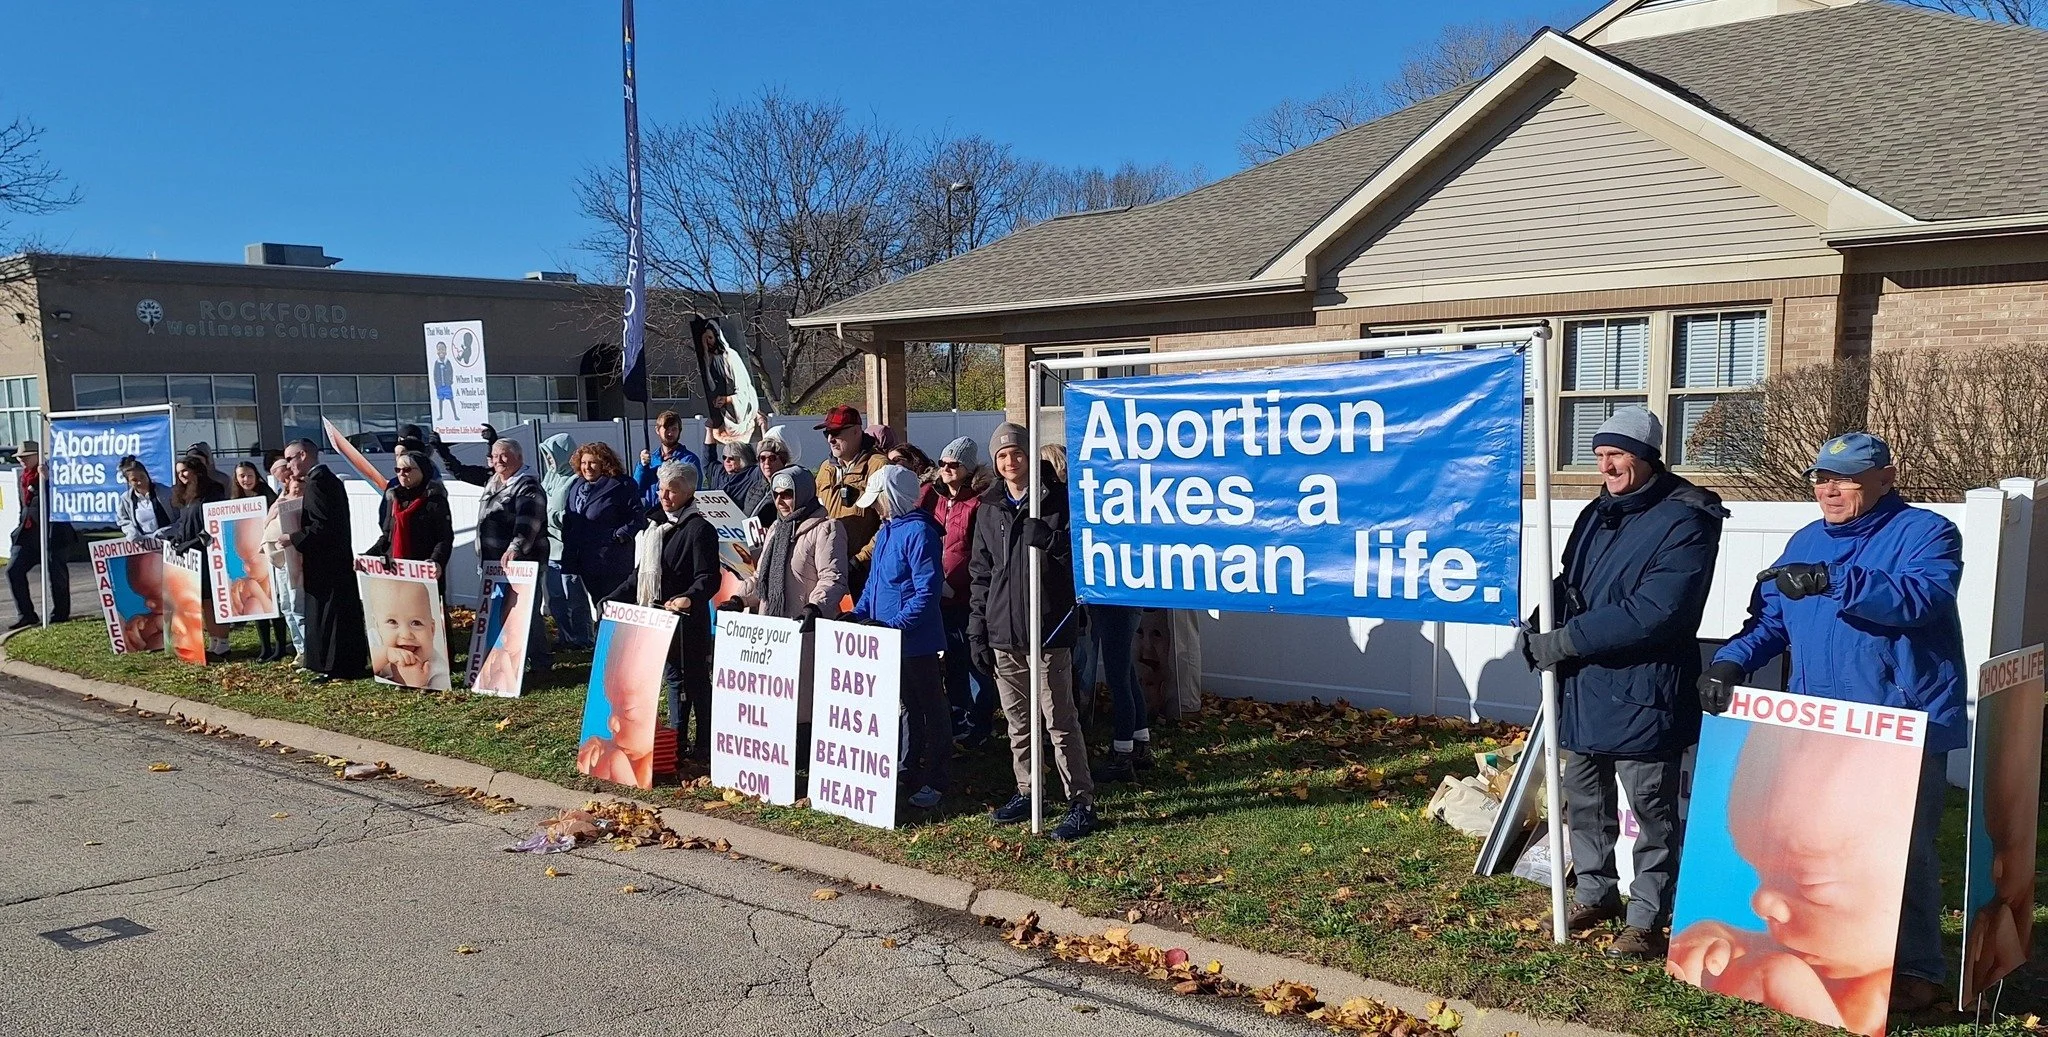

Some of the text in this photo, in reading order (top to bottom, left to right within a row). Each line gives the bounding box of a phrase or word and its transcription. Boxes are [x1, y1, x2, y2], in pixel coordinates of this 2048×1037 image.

[200, 300, 347, 324] ROCKFORD
[166, 320, 379, 340] Wellness Collective
[456, 375, 470, 384] When
[456, 388, 485, 396] A Whole Lot
[1078, 389, 1386, 461] Abortion
[52, 428, 140, 458] Abortion
[52, 458, 106, 485] takes
[53, 487, 119, 513] human
[701, 494, 729, 506] stop
[1078, 463, 1341, 526] takes a
[207, 502, 262, 517] ABORTION KILLS
[708, 510, 730, 518] can
[717, 525, 746, 541] elp
[93, 541, 139, 559] ABORTION
[209, 520, 229, 619] BABIES
[409, 563, 434, 579] LIFE
[515, 566, 533, 577] KILLS
[1081, 529, 1502, 603] human life.
[95, 560, 126, 653] BABIES
[604, 604, 675, 628] CHOOSE LIFE
[726, 620, 791, 646] Change your
[834, 630, 879, 660] YOUR
[740, 646, 772, 665] mind?
[2021, 650, 2044, 680] LIFE
[717, 667, 795, 699] ABORTION
[831, 667, 877, 698] BABY
[738, 702, 768, 727] PILL
[829, 704, 879, 737] HAS A
[1731, 692, 1917, 742] HOOSE LIFE
[717, 732, 789, 766] REVERSAL
[816, 739, 890, 779] BEATING
[735, 770, 769, 796] .COM
[819, 777, 877, 814] HEART
